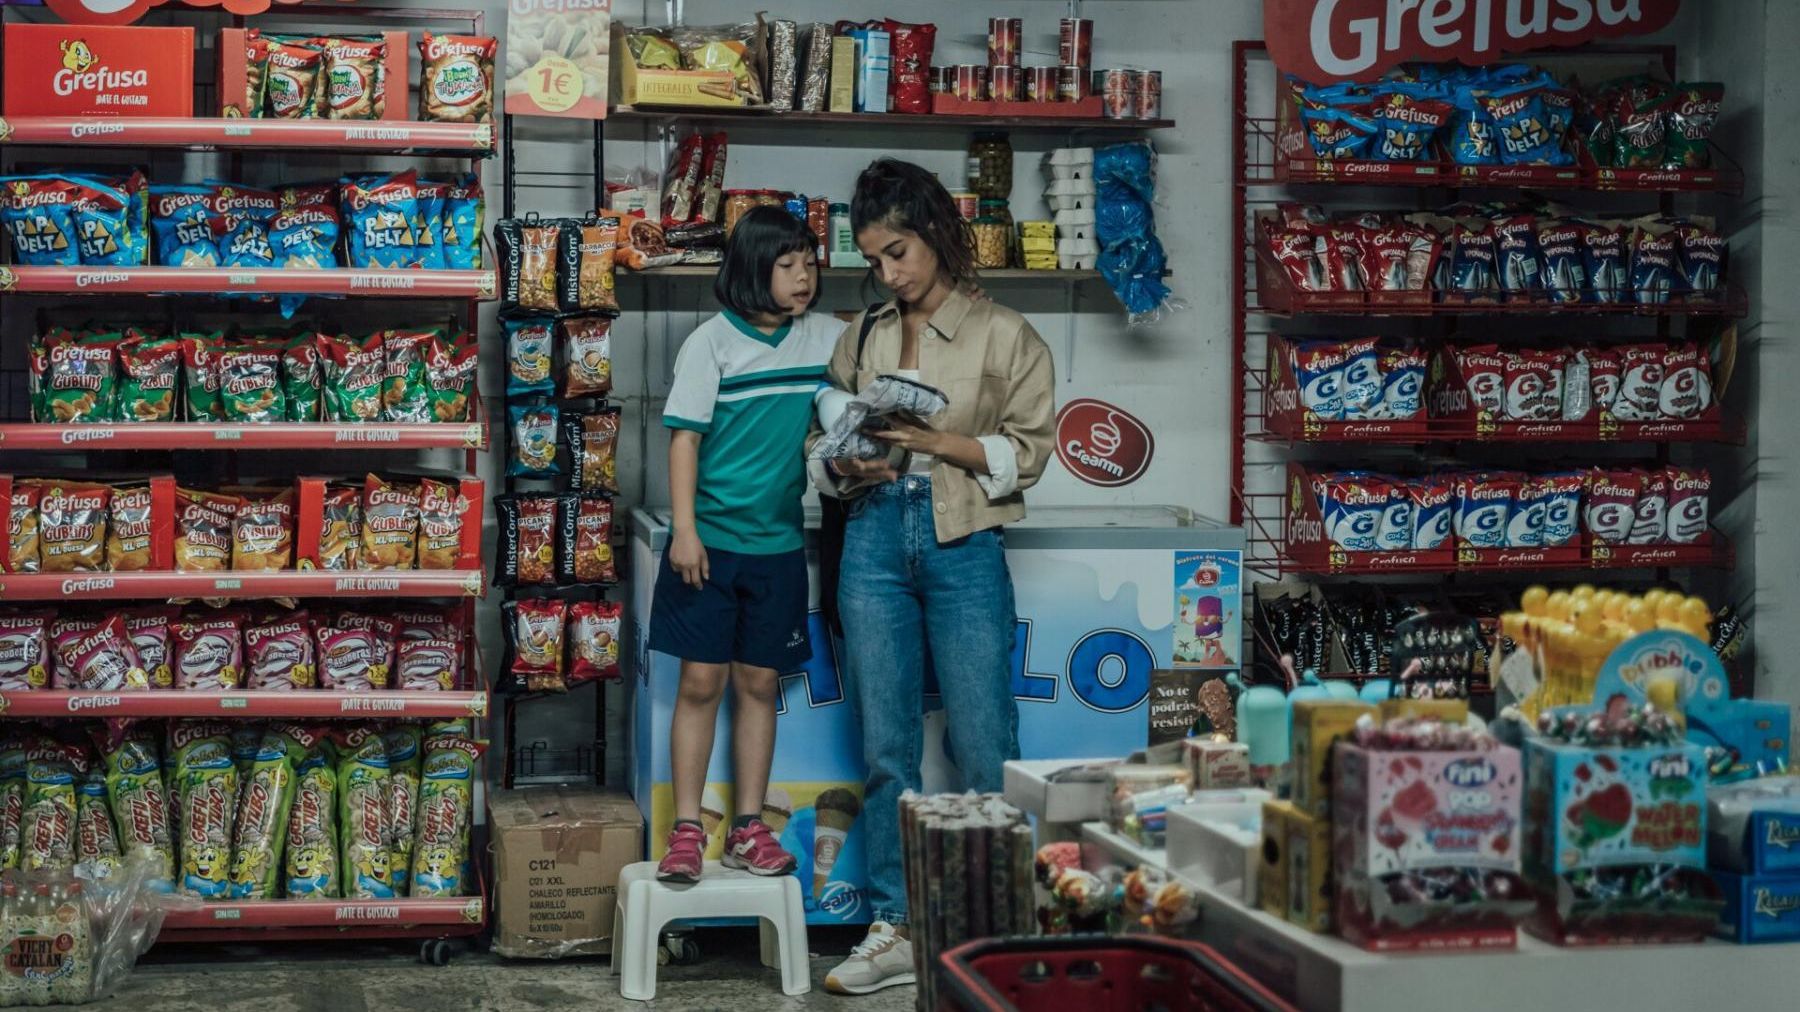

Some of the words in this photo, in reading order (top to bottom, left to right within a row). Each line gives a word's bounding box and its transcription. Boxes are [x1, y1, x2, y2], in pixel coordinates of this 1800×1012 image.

[1309, 0, 1643, 77] Grefusa
[427, 42, 485, 60] Grefusa
[53, 66, 148, 96] Grefusa
[1383, 106, 1440, 126] Grefusa
[71, 121, 125, 138] Grefusa
[1343, 163, 1390, 177] Grefusa
[214, 195, 276, 214] Grefusa
[1538, 230, 1578, 247] Grefusa
[507, 235, 519, 302] MisterCorn
[566, 236, 579, 302] MisterCorn
[76, 273, 129, 288] Grefusa
[51, 345, 112, 362] Grefusa
[1466, 354, 1501, 369] Grefus
[1506, 358, 1550, 375] Grefusa
[61, 428, 115, 444] Grefusa
[1344, 488, 1388, 506] Grefusa
[1472, 487, 1511, 501] Grefusa
[1593, 482, 1636, 499] Grefusa
[40, 494, 102, 514] Grefusa
[111, 491, 151, 513] Grefu
[1287, 510, 1323, 547] Grefusa
[505, 508, 518, 575] MisterCorn
[563, 508, 576, 575] MisterCorn
[61, 579, 115, 595] Grefusa
[245, 621, 302, 647] Grefusa
[63, 627, 115, 669] Grefusa
[1157, 686, 1174, 698] No
[67, 696, 121, 712] Grefusa
[528, 859, 556, 872] C121
[528, 888, 563, 899] CHALECO
